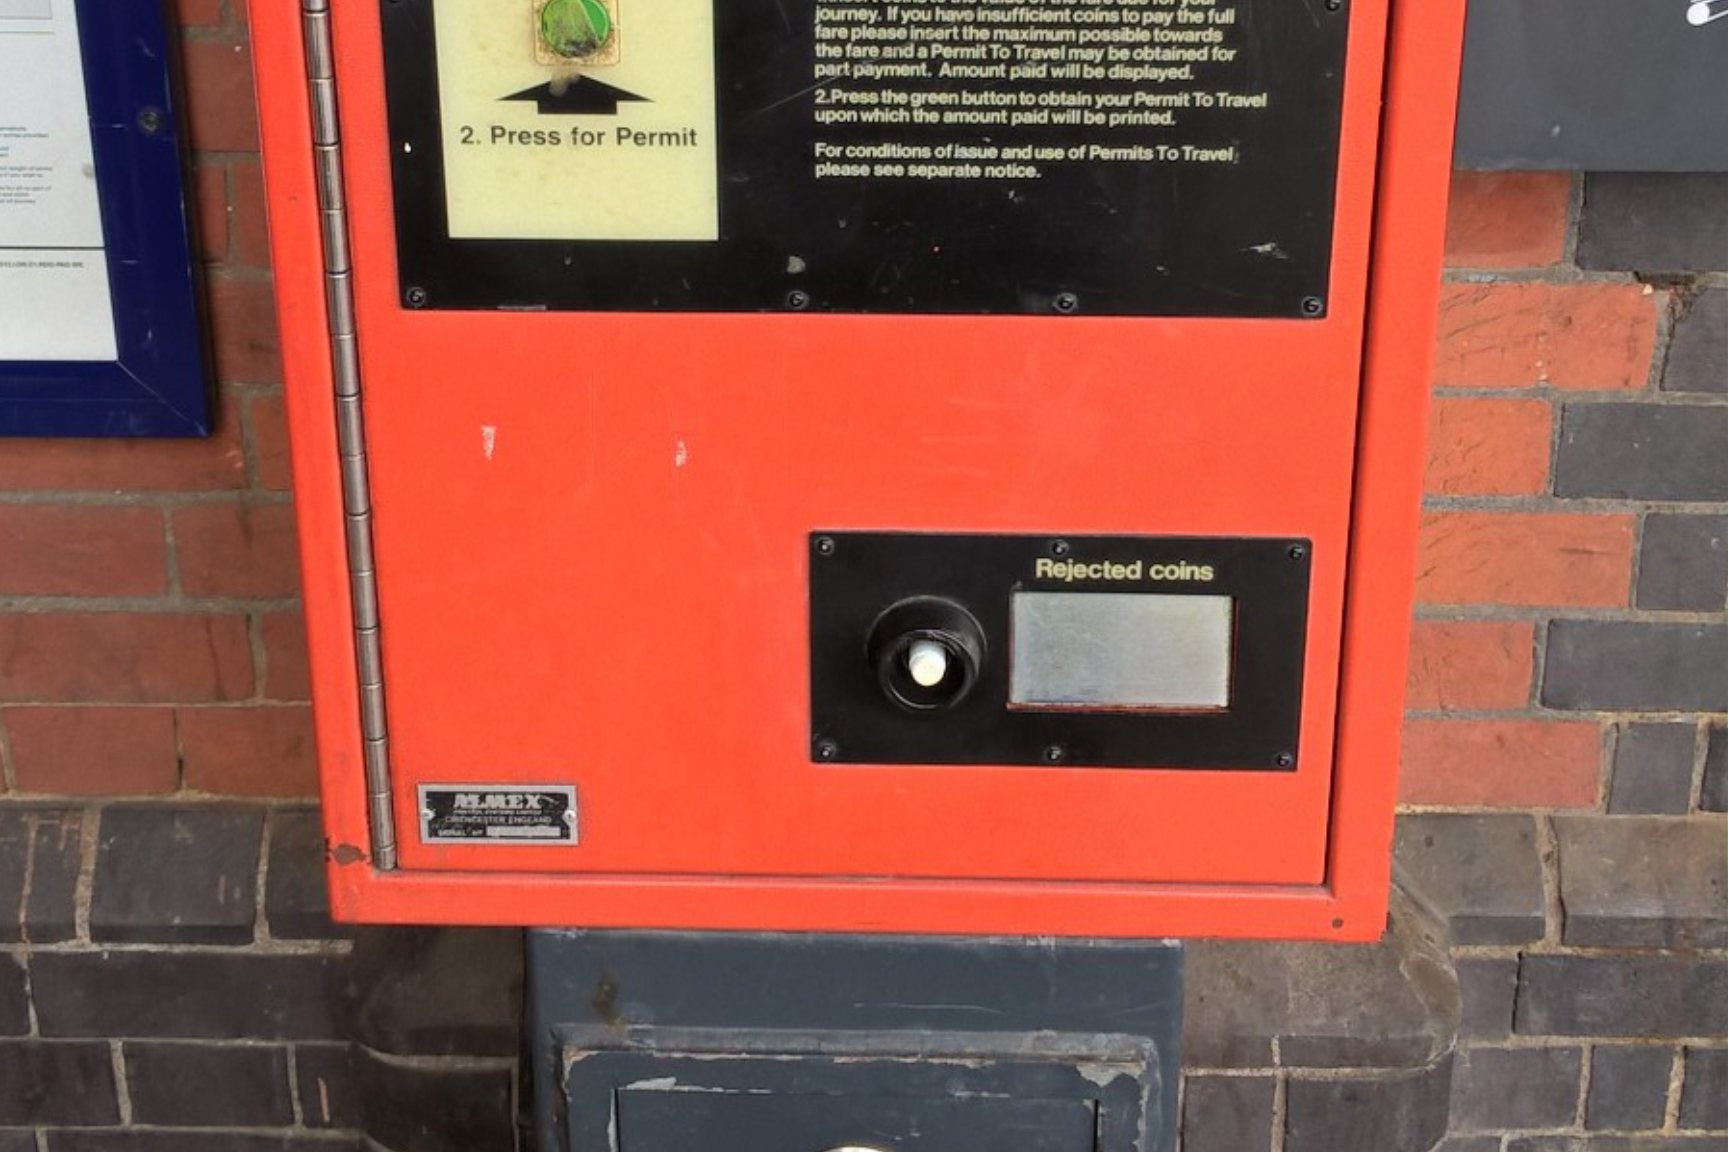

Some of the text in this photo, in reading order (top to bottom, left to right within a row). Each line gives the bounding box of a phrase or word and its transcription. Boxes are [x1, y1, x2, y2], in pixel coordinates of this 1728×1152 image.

[814, 6, 1235, 27] journey. If you have insufficient coins to pay the full
[814, 24, 1224, 45] fare please insert the maximum possible towards
[815, 43, 1236, 63] the fare and a Permit To Travel may be obtained for
[814, 62, 1194, 82] part payment. Amount paid will be displayed.
[881, 90, 908, 104] the
[910, 93, 959, 108] green
[961, 90, 1016, 105] button
[1019, 92, 1035, 105] to
[1038, 91, 1092, 106] obtain
[1095, 94, 1132, 109] your
[1134, 92, 1190, 107] Permit
[1192, 92, 1213, 107] To
[1216, 92, 1268, 107] Travel
[814, 108, 1176, 128] upon which the amount paid will be printed.
[461, 126, 697, 146] 2. Press for Permit
[814, 143, 844, 158] For
[846, 143, 931, 159] conditions
[934, 144, 952, 159] of
[954, 144, 998, 159] issue
[1001, 145, 1032, 159] and
[1034, 148, 1065, 160] use
[1068, 145, 1086, 160] of
[1089, 145, 1154, 161] Permits
[1156, 146, 1179, 161] To
[814, 163, 1042, 181] please see separate notice.
[1036, 558, 1214, 582] Rejected coins
